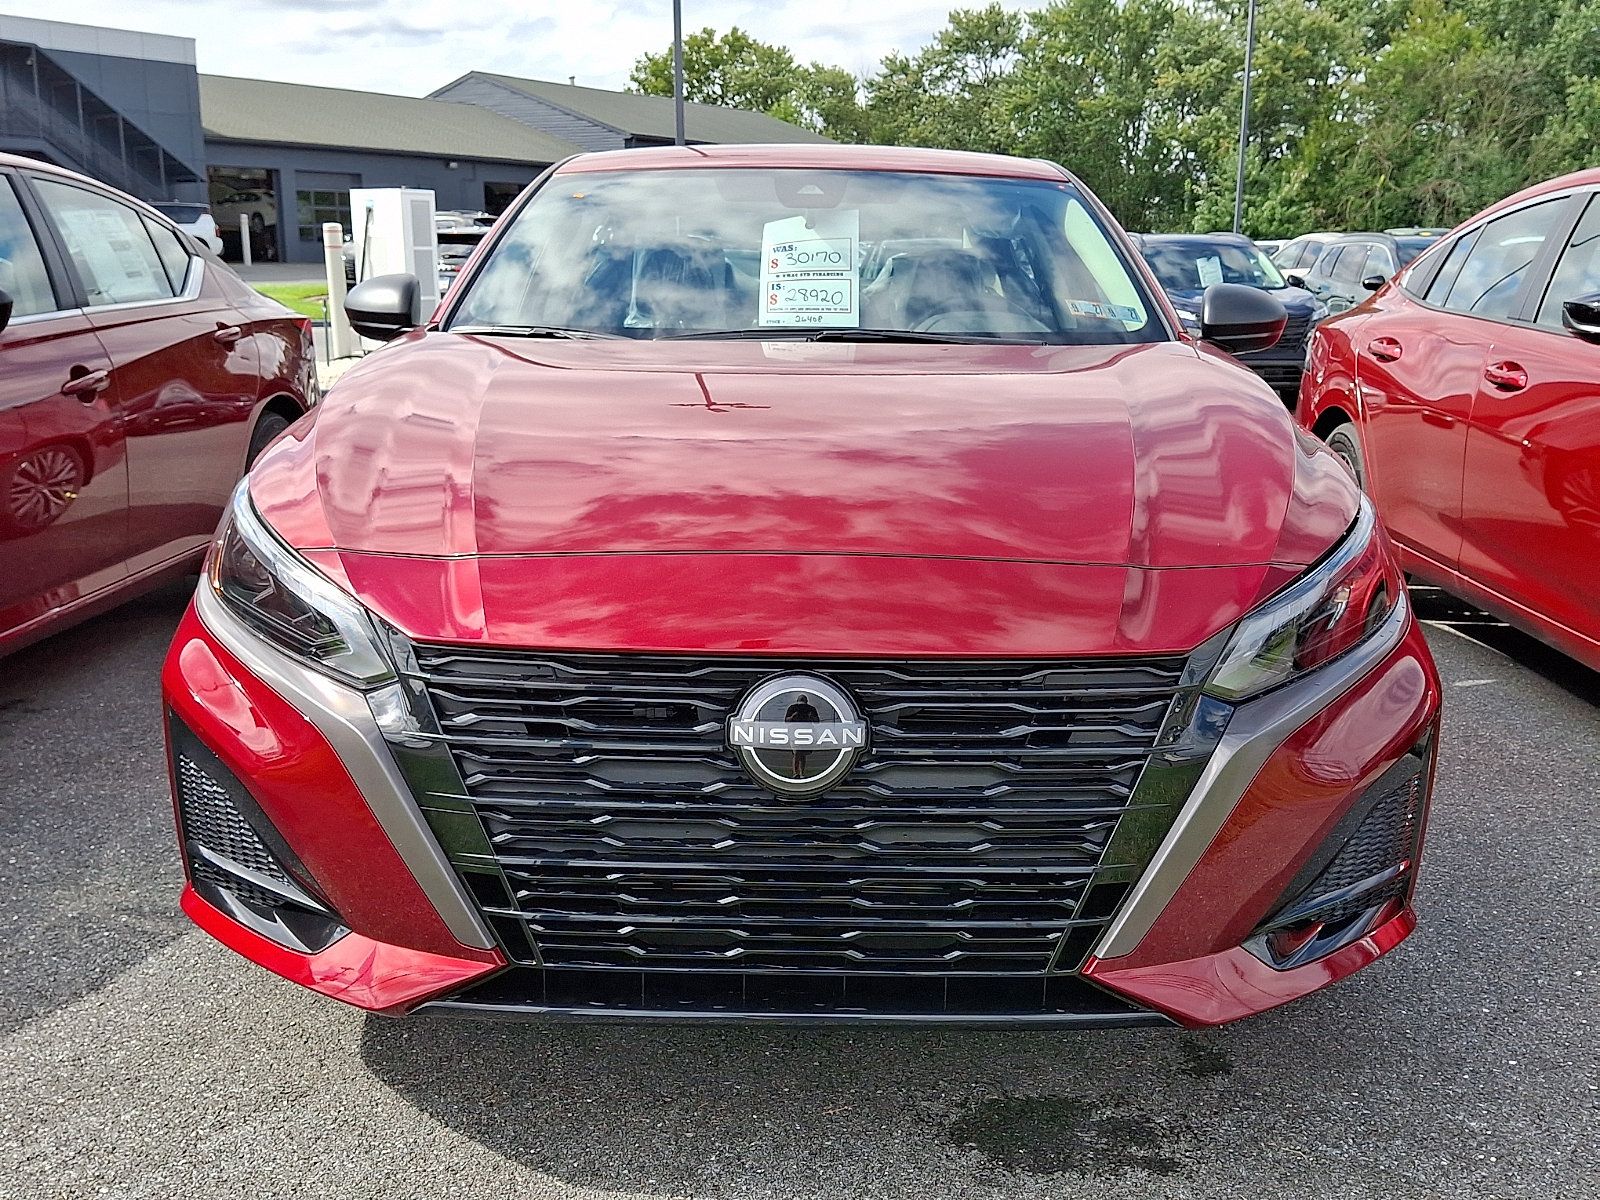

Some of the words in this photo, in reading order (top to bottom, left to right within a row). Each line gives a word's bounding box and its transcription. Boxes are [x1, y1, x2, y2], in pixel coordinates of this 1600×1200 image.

[772, 244, 798, 253] WAS:
[785, 251, 842, 266] 30170
[771, 283, 786, 291] IS:
[785, 288, 844, 305] 28920
[734, 725, 862, 745] NISSAN
